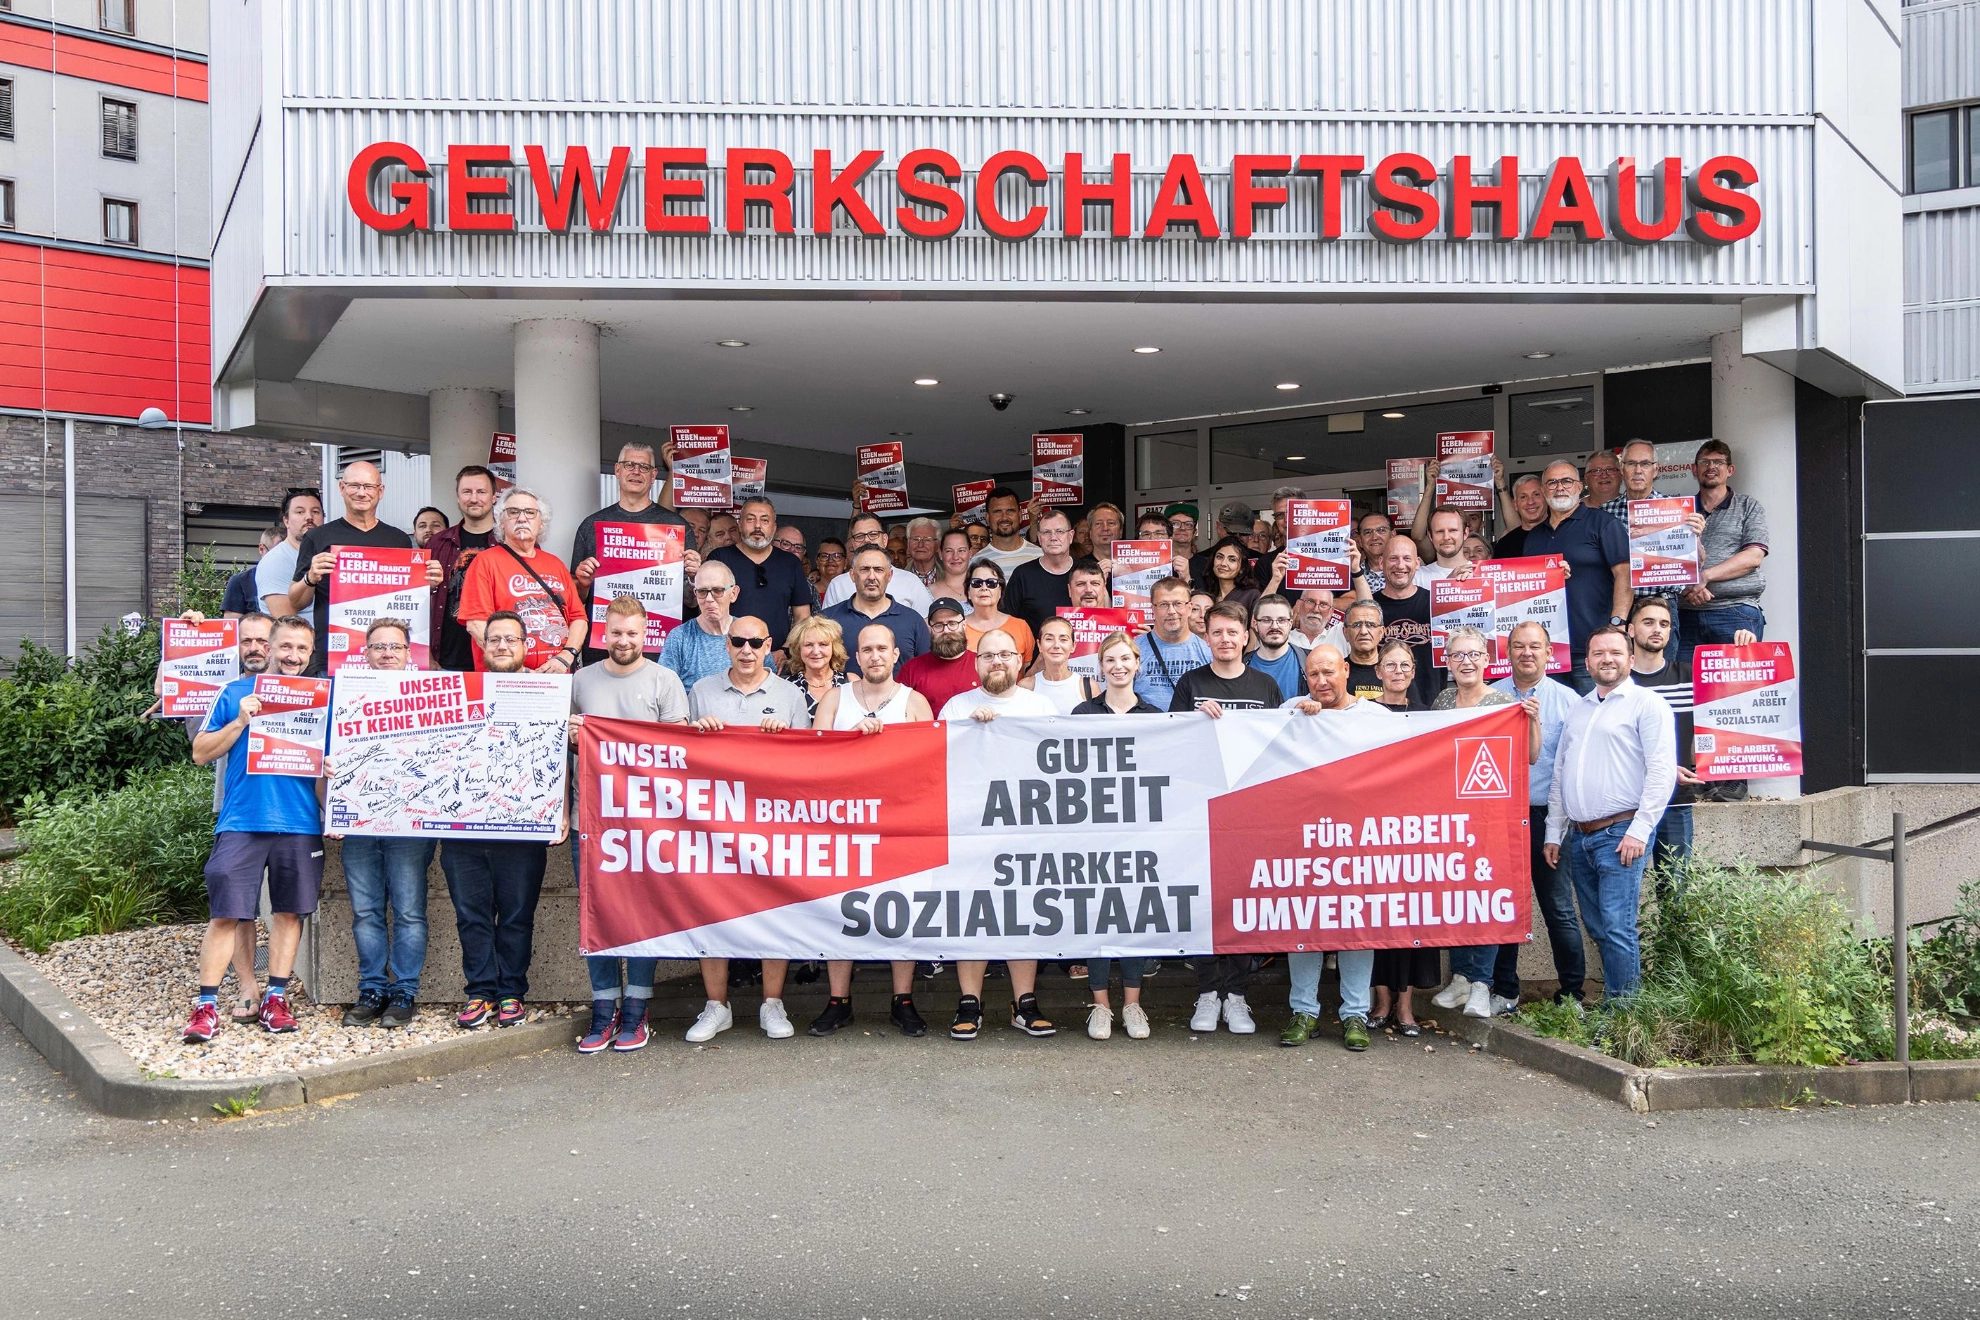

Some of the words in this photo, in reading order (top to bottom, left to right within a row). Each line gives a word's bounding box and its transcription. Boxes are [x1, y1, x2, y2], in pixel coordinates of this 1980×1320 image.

[347, 141, 1761, 244] GEWERKSCHAFTSHAUS
[1441, 447, 1482, 455] SICHERHEIT
[861, 457, 893, 465] SICHERHEIT
[1634, 508, 1660, 517] LEBEN
[1634, 515, 1682, 525] SICHERHEIT
[603, 527, 623, 535] UNSER
[604, 535, 635, 547] LEBEN
[636, 540, 666, 548] BRAUCHT
[1644, 544, 1684, 552] SOZIALSTAAT
[603, 547, 665, 561] SICHERHEIT
[340, 560, 378, 571] LEBEN
[1481, 564, 1501, 572] UNSER
[339, 573, 410, 585] SICHERHEIT
[643, 576, 674, 585] ARBEIT
[1517, 572, 1546, 580] BRAUCHT
[1639, 575, 1691, 583] UMVERTEILUNG
[607, 582, 634, 590] STARKER
[1436, 587, 1461, 595] LEBEN
[1436, 594, 1482, 603] SICHERHEIT
[1527, 605, 1557, 614] ARBEIT
[170, 629, 198, 637] LEBEN
[170, 638, 223, 647] SICHERHEIT
[1701, 658, 1739, 670] LEBEN
[1741, 660, 1774, 668] BRAUCHT
[1701, 669, 1775, 683] SICHERHEIT
[260, 684, 289, 694] LEBEN
[400, 675, 461, 695] UNSERE
[260, 693, 314, 706] SICHERHEIT
[362, 692, 462, 717] GESUNDHEIT
[1752, 698, 1787, 707] ARBEIT
[293, 716, 318, 724] ARBEIT
[338, 721, 362, 737] IST
[367, 714, 414, 733] KEINE
[417, 708, 464, 727] WARE
[1716, 715, 1780, 725] SOZIALSTAAT
[266, 727, 312, 736] SOZIALSTAAT
[283, 748, 308, 757] ARBEIT,
[1728, 745, 1742, 754] FÜR
[1743, 744, 1778, 753] ARBEIT,
[261, 754, 305, 763] AUFSCHWUNG
[600, 741, 687, 769] UNSER
[1036, 737, 1136, 774] GUTE
[1714, 754, 1775, 764] AUFSCHWUNG
[1777, 754, 1783, 762] &
[257, 761, 315, 771] UMVERTEILUNG
[1709, 763, 1791, 774] UMVERTEILUNG
[600, 774, 746, 822] LEBEN
[755, 798, 882, 824] BRAUCHT
[981, 775, 1170, 826] ARBEIT
[484, 824, 522, 832] Reformplänen
[1303, 817, 1353, 848] FÜR
[1360, 813, 1475, 847] ARBEIT,
[599, 828, 880, 877] SICHERHEIT
[994, 850, 1159, 886] STARKER
[1250, 852, 1466, 888] AUFSCHWUNG
[1474, 857, 1493, 881] &
[840, 885, 1199, 938] SOZIALSTAAT
[1232, 888, 1515, 932] UMVERTEILUNG
